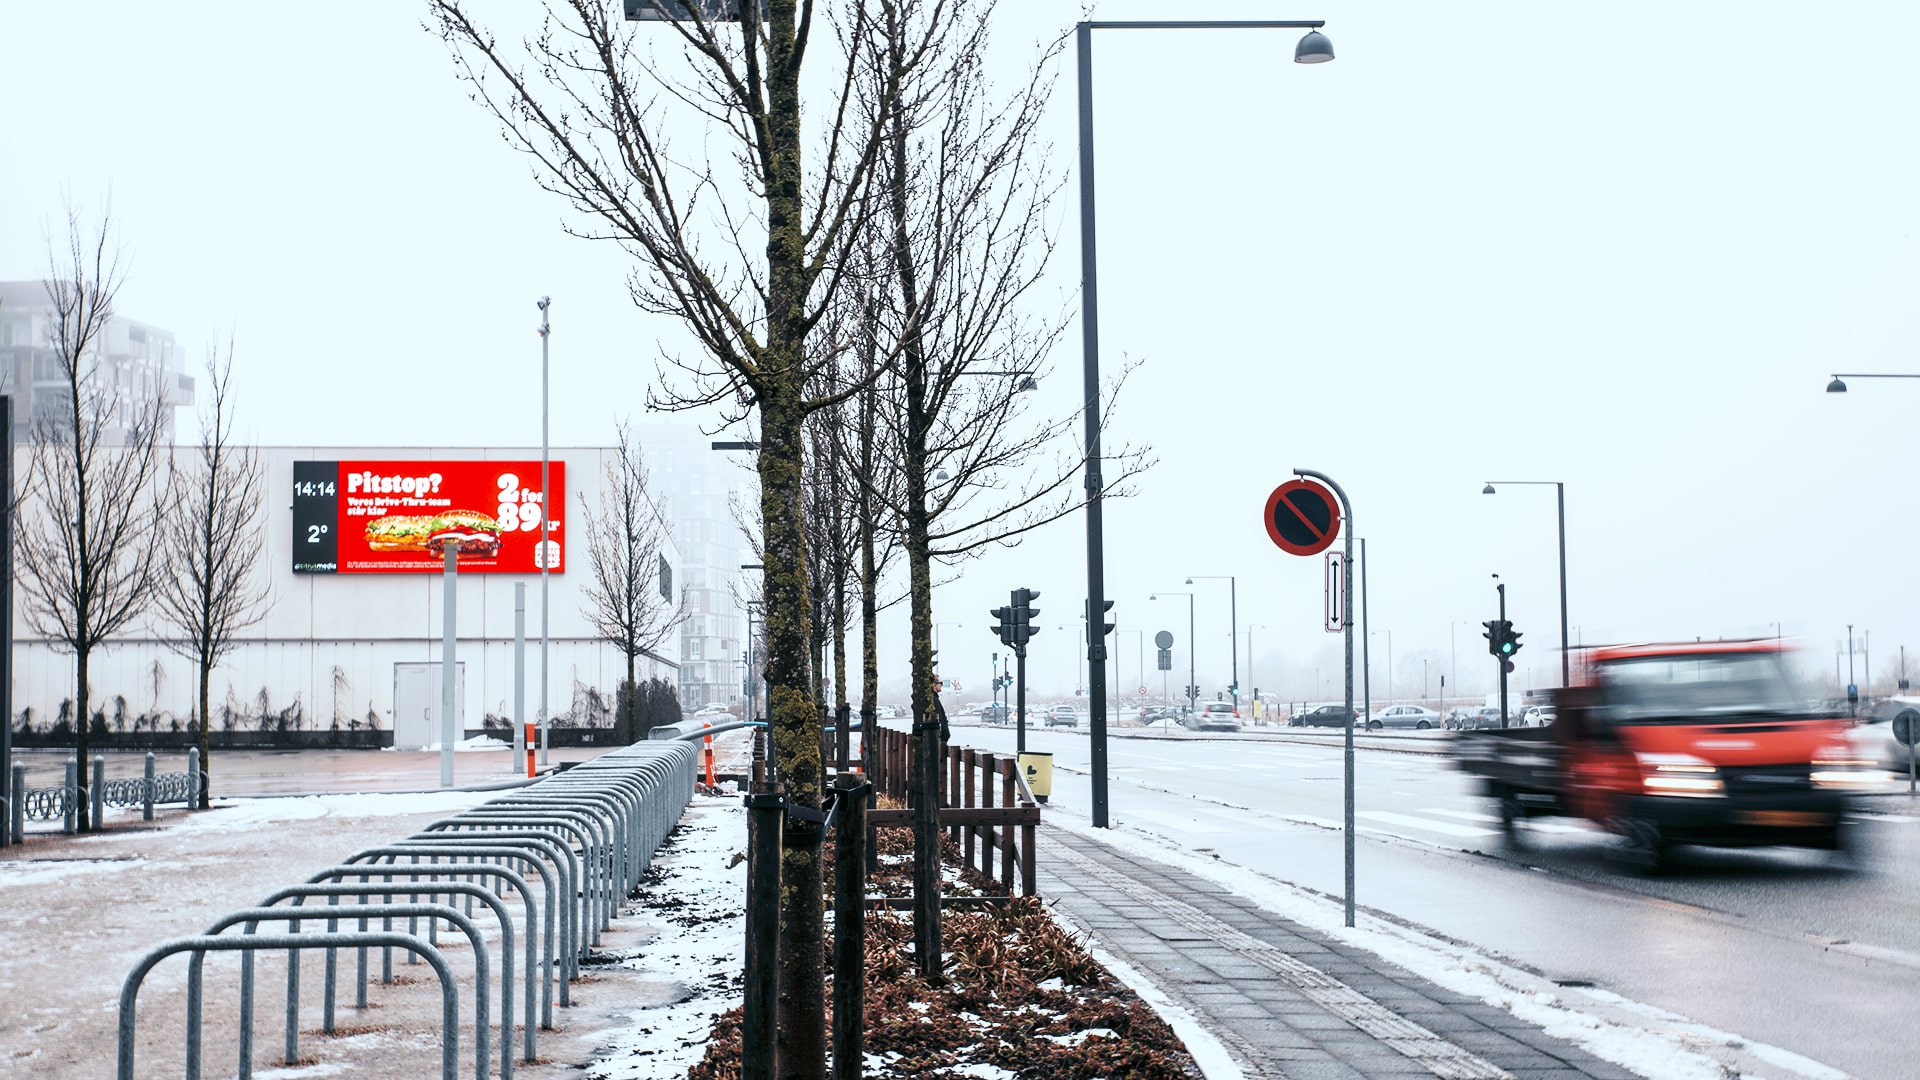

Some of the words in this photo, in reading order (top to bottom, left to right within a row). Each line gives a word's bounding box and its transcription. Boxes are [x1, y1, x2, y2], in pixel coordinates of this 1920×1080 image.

[294, 481, 336, 497] 14:14
[347, 470, 443, 498] Pitstop?
[497, 473, 520, 503] 2
[521, 488, 543, 503] for
[347, 497, 374, 506] Vores
[347, 506, 366, 516] står
[367, 506, 388, 516] klar
[497, 502, 542, 532] 89
[307, 524, 328, 543] 2°
